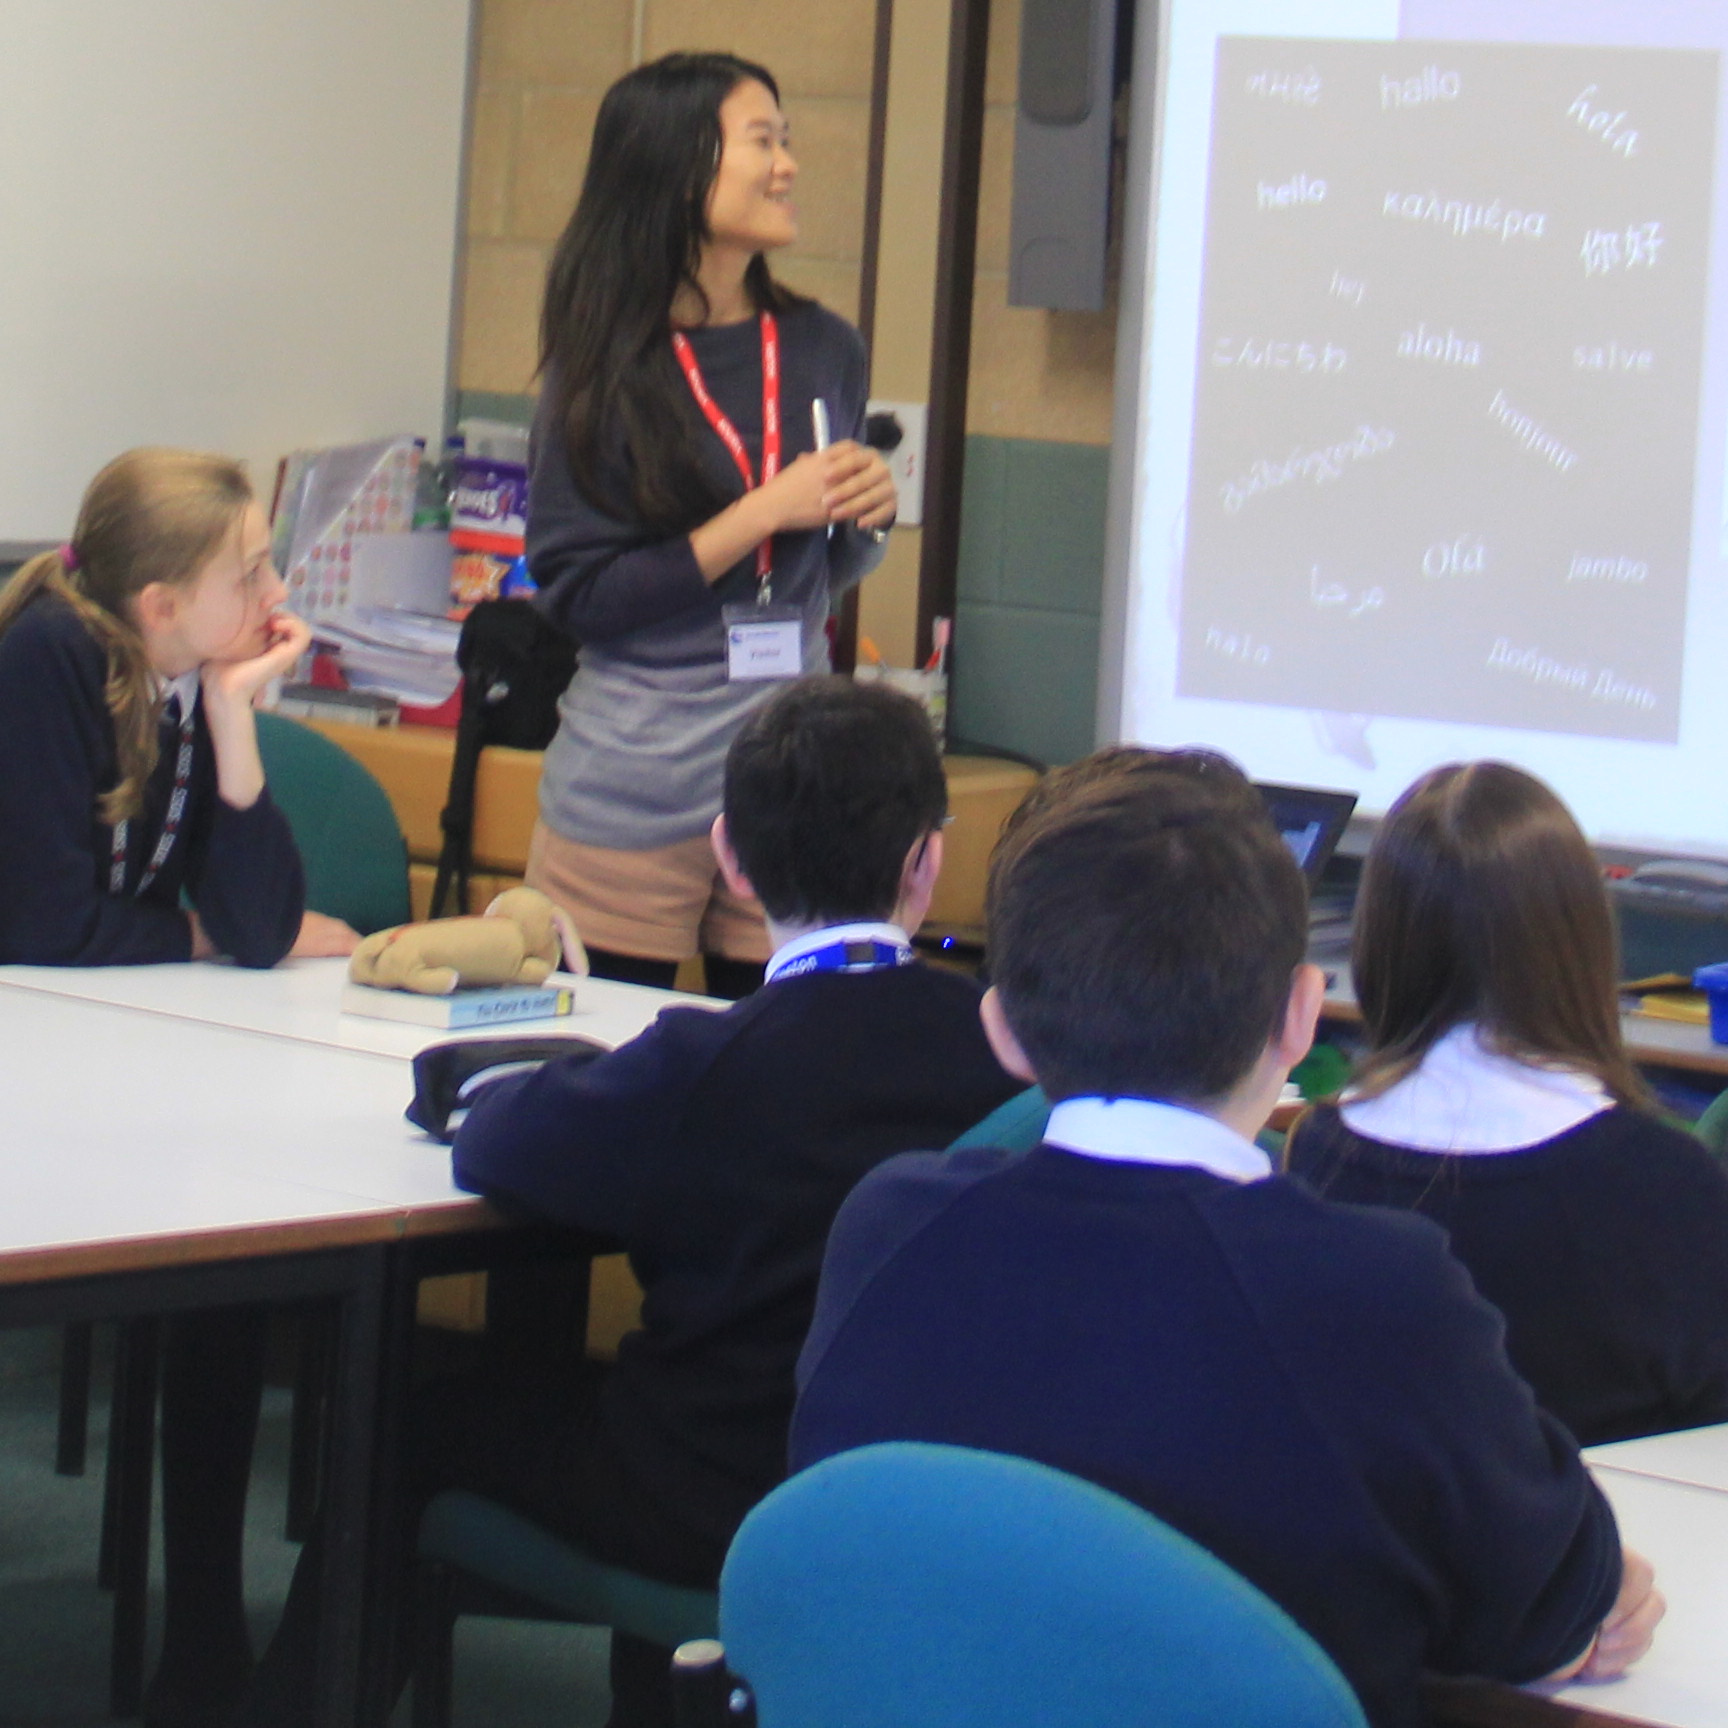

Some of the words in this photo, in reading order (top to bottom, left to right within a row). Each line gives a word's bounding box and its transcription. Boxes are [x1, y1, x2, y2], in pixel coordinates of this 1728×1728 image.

[1378, 63, 1462, 113] hallo
[1566, 82, 1641, 160] hola
[1256, 170, 1329, 213] hello
[1382, 189, 1547, 246] καλημέρα
[1578, 220, 1666, 280] 你好
[1396, 321, 1484, 369] aloha
[1572, 338, 1655, 373] salve
[1486, 387, 1581, 474] bonjour
[1564, 549, 1651, 586] jambo
